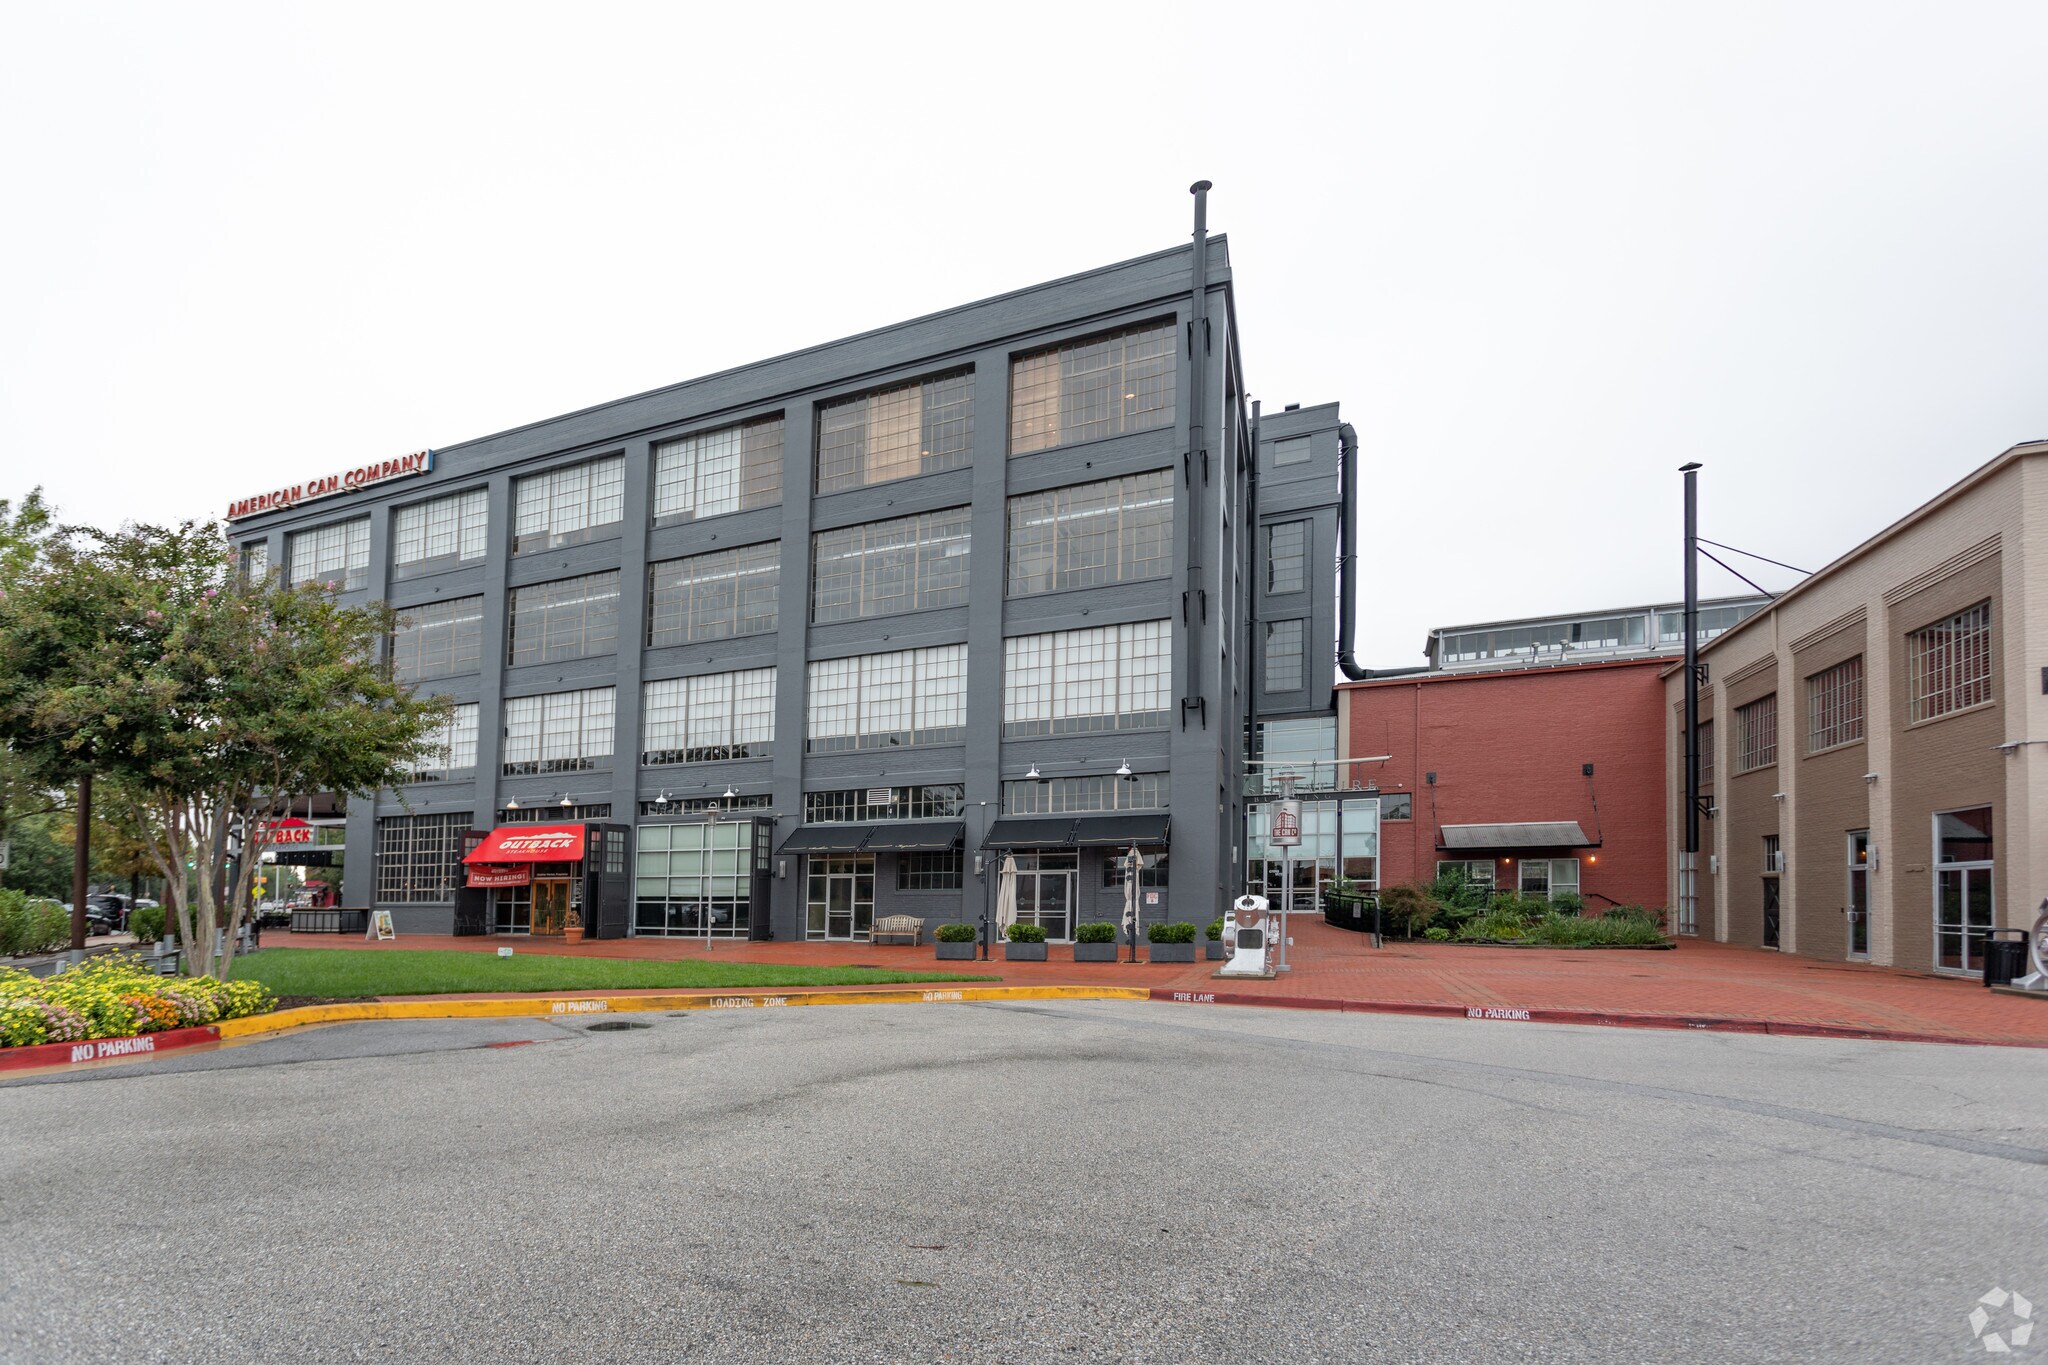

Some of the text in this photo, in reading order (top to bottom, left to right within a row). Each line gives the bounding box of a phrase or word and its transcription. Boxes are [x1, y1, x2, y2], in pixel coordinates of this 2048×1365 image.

[227, 452, 426, 517] AMERICAN CAN COMPANY
[1254, 793, 1331, 803] BUIDING
[499, 839, 573, 849] OUTBACK
[494, 873, 526, 882] HIRING!
[923, 991, 962, 1001] NO PARKING
[1173, 992, 1215, 1002] FIRE LANE
[552, 1000, 608, 1013] NO PARKING
[709, 997, 788, 1008] LOADING ZONE
[1467, 1007, 1530, 1020] NO PARKING
[71, 1036, 155, 1063] NO PARKING
